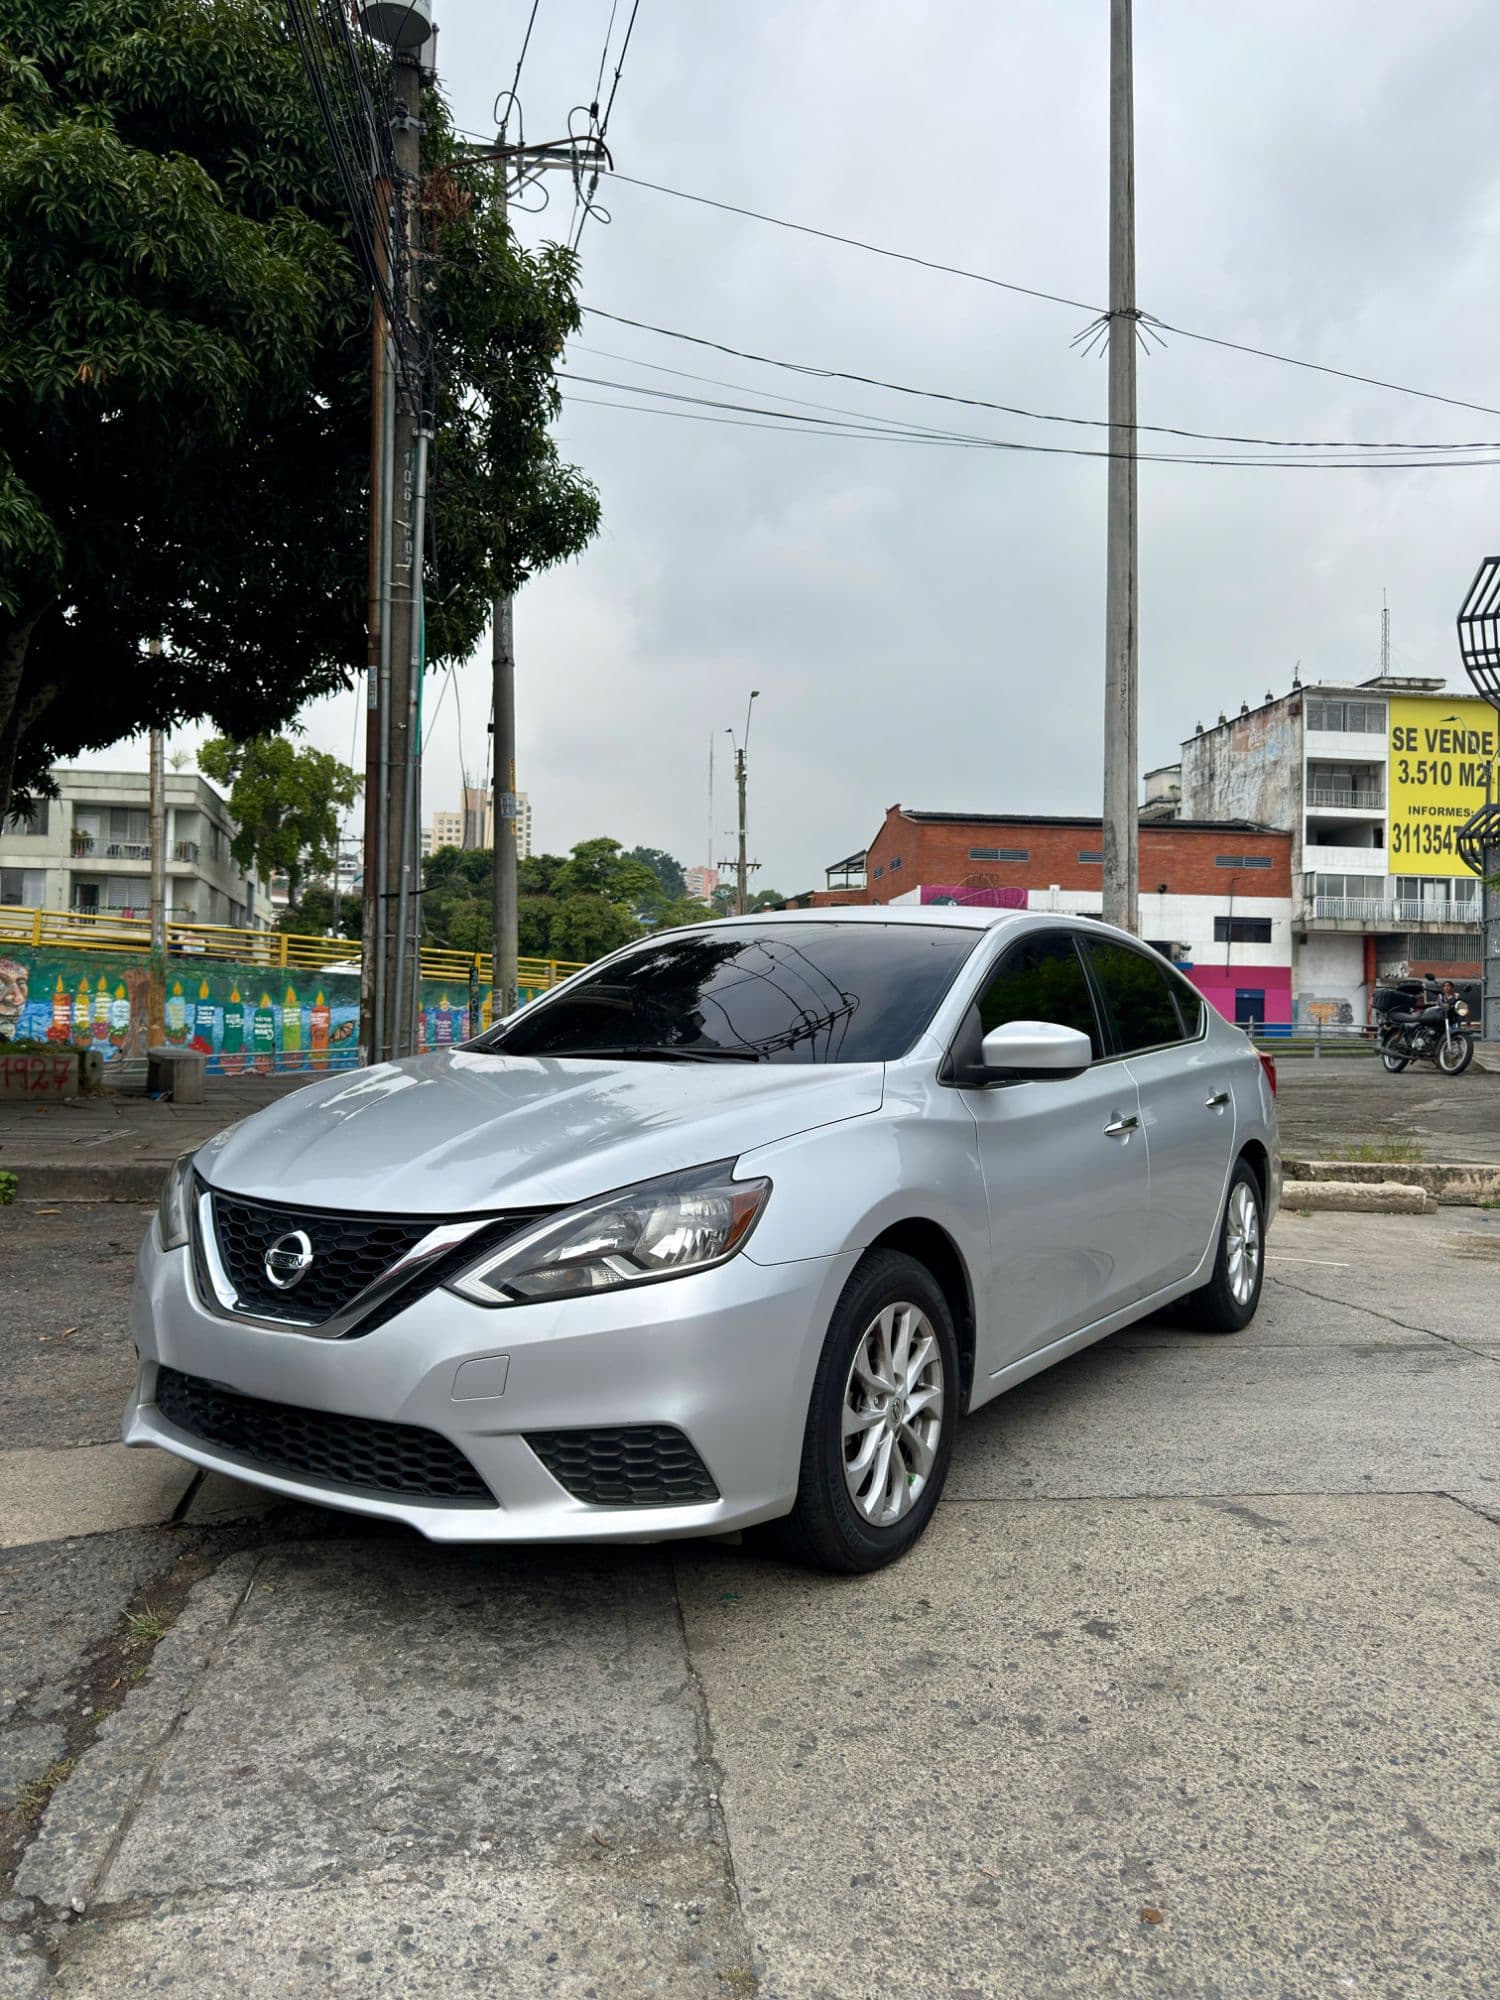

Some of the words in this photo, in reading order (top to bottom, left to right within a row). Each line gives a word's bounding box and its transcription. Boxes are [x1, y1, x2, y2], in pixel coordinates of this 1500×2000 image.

[1392, 726, 1418, 752] SE
[1424, 728, 1494, 756] VENDE
[1398, 759, 1452, 786] 3.510
[1, 1055, 72, 1091] 1927
[266, 1250, 304, 1267] NISSAN
